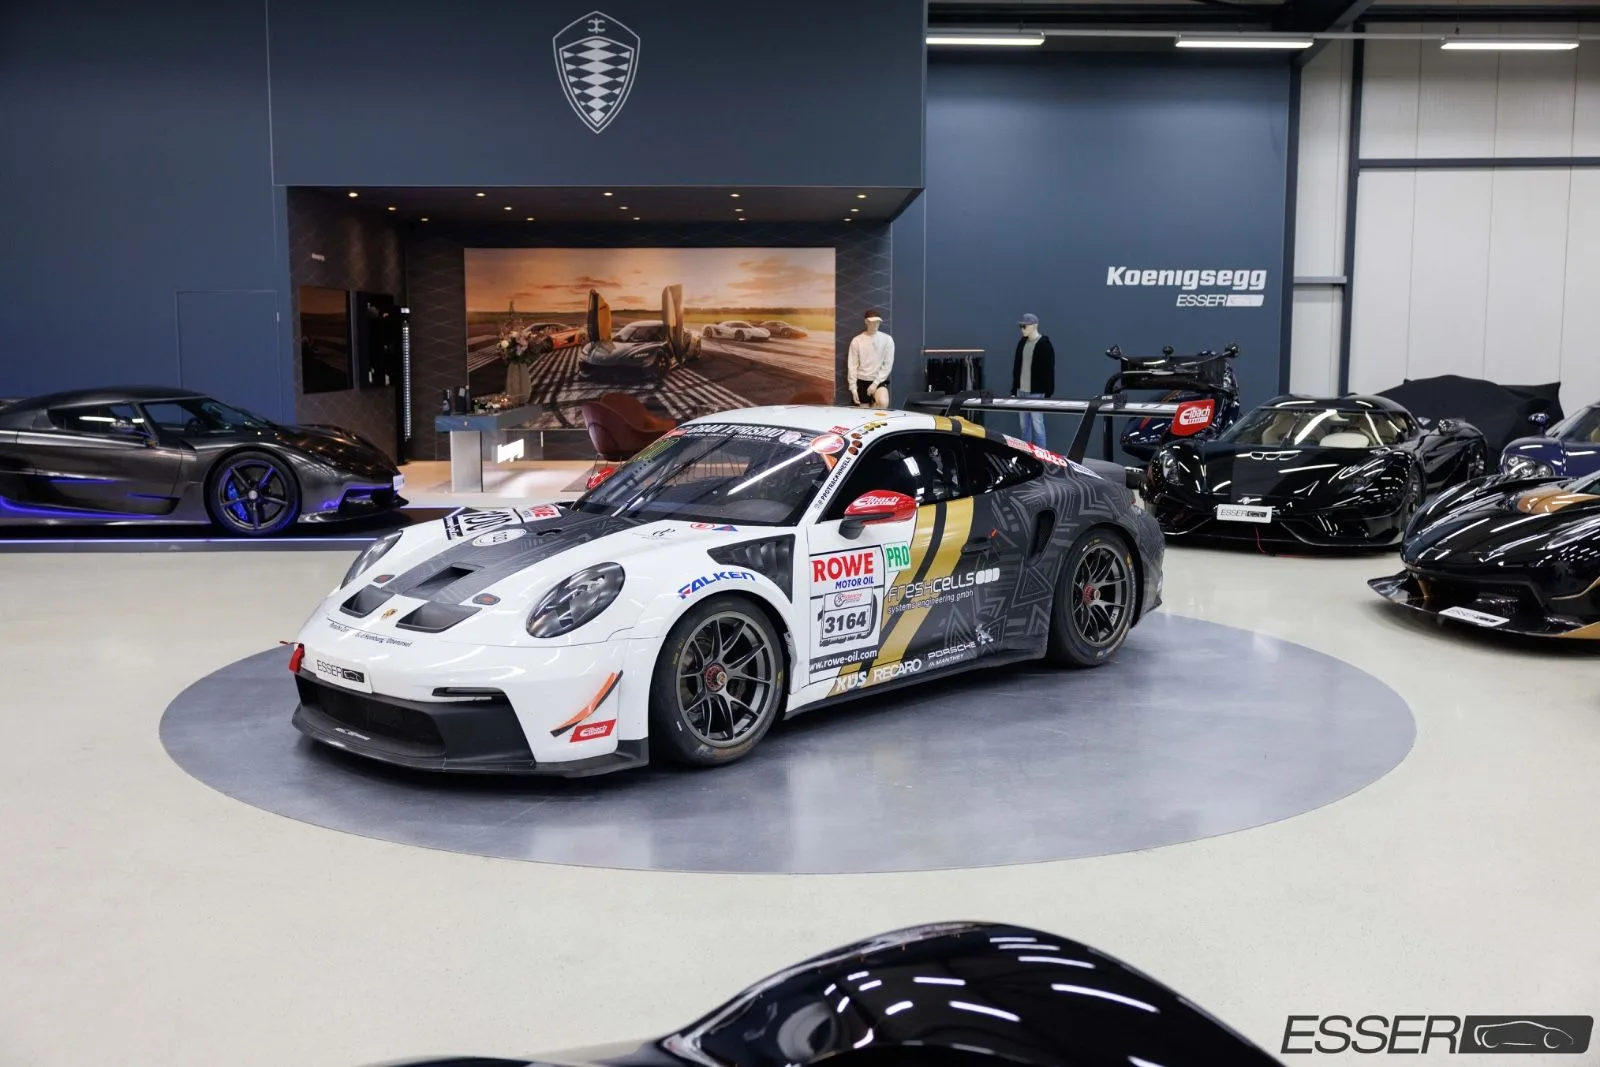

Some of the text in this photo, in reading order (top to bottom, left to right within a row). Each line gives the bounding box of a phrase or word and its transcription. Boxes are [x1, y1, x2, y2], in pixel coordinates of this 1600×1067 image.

[1106, 265, 1267, 291] Koenigsegg
[1176, 294, 1227, 307] ESSER
[811, 552, 874, 582] ROWE
[886, 545, 910, 568] PRO
[678, 571, 756, 600] FALKEN
[835, 576, 875, 589] MOTOR OIL
[887, 602, 916, 614] systems
[824, 611, 867, 633] 3164
[928, 641, 976, 659] PORSCHE
[317, 659, 343, 678] ESSER
[874, 659, 922, 682] RECARO
